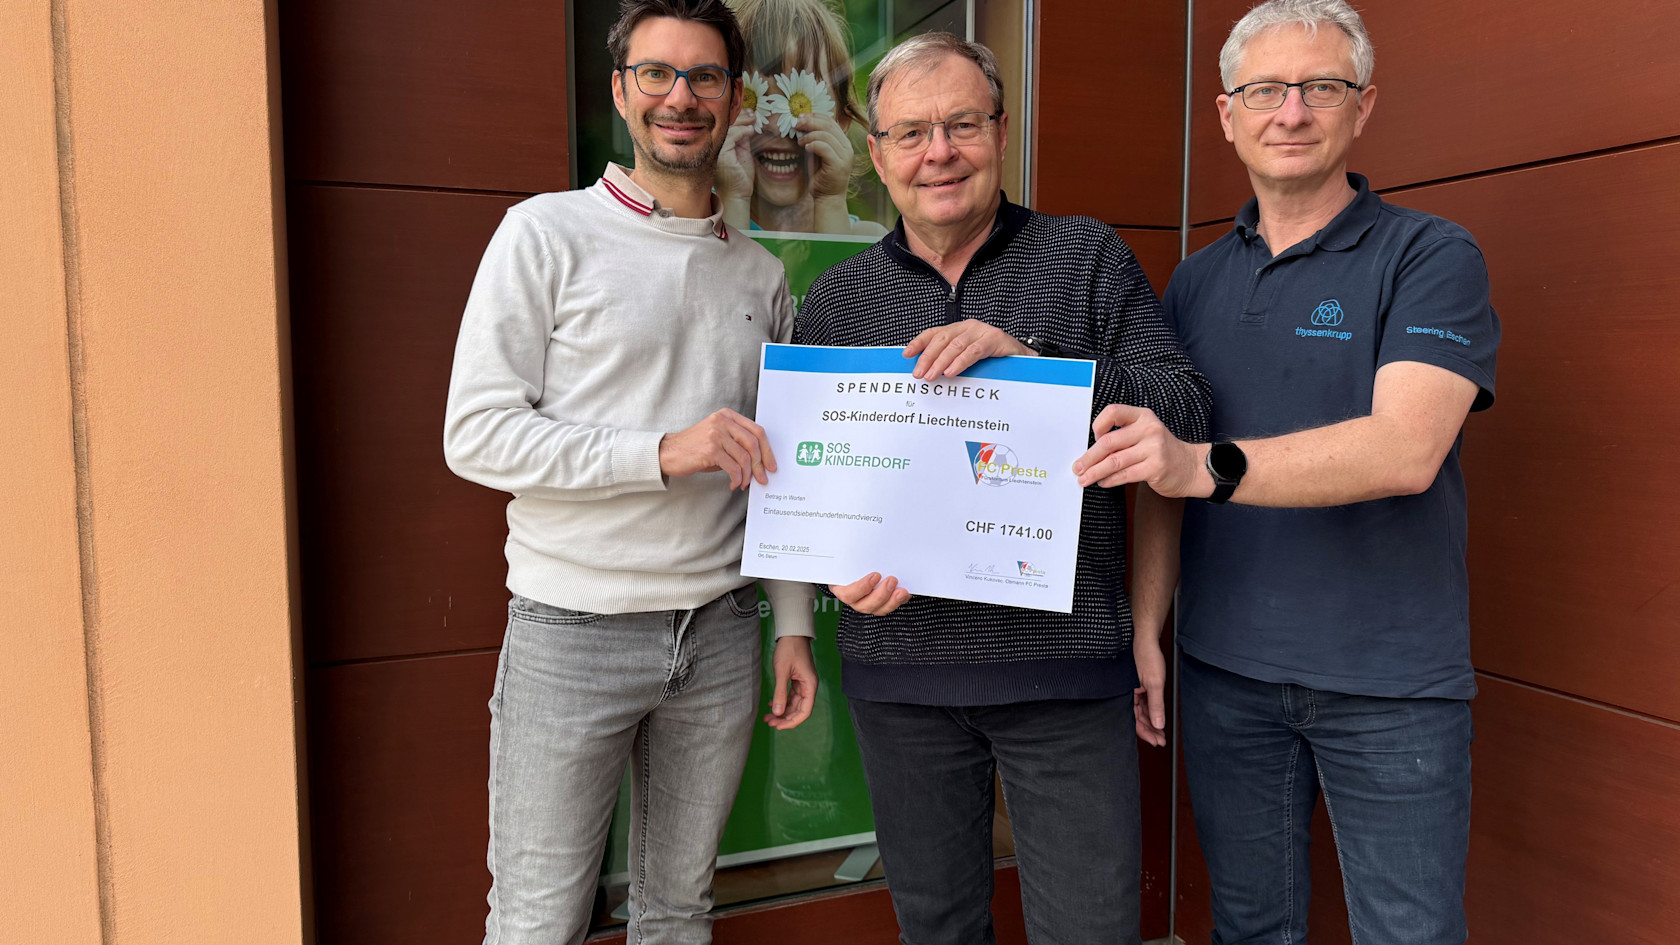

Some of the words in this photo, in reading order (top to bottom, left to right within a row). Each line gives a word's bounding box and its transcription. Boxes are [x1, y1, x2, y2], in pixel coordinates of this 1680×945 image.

[1295, 326, 1352, 340] thyssenkrupp
[1406, 325, 1444, 339] Steering
[1446, 330, 1471, 347] Eschen
[836, 382, 1000, 400] SPENDENSCHECK
[905, 400, 915, 408] für
[822, 410, 915, 424] SOS-Kinderdorf
[918, 413, 1010, 431] Liechtenstein
[826, 442, 851, 454] SOS
[825, 455, 911, 470] KINDERDORF
[978, 461, 997, 473] FC
[1001, 463, 1047, 478] Presta
[1009, 478, 1042, 486] Liechtenstein
[765, 493, 782, 501] Betrag
[965, 520, 996, 534] CHF
[1000, 524, 1053, 540] 1741.00
[781, 544, 810, 553] 20.02.2025
